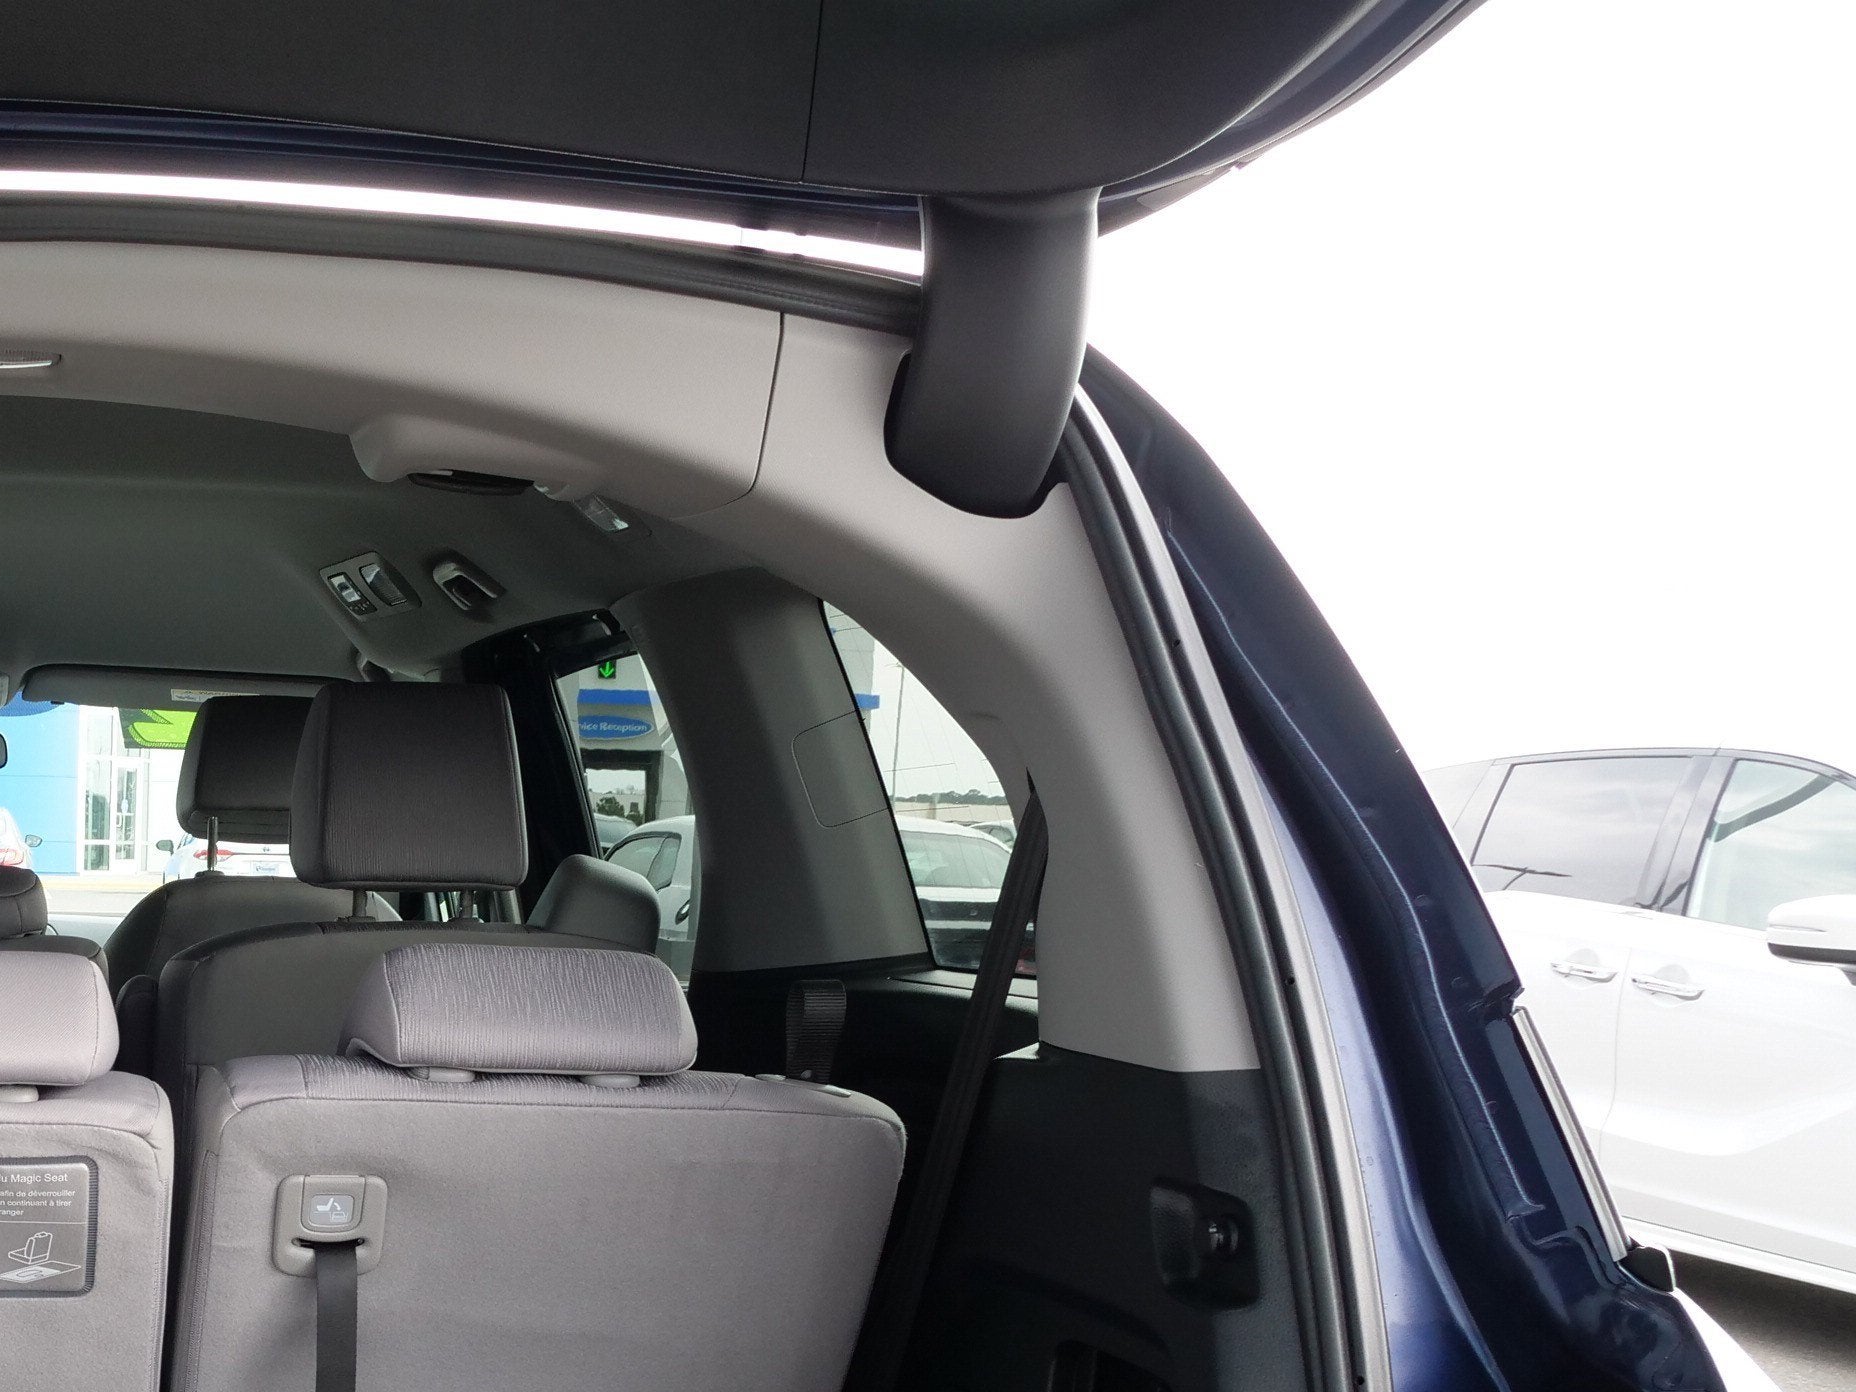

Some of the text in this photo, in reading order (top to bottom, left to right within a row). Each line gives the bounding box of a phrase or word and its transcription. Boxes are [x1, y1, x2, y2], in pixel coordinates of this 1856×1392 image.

[599, 722, 648, 733] Reception
[10, 1173, 42, 1185] Magic
[43, 1173, 69, 1183] Seat
[0, 1189, 14, 1197] afin
[27, 1189, 76, 1197] déverrouiller
